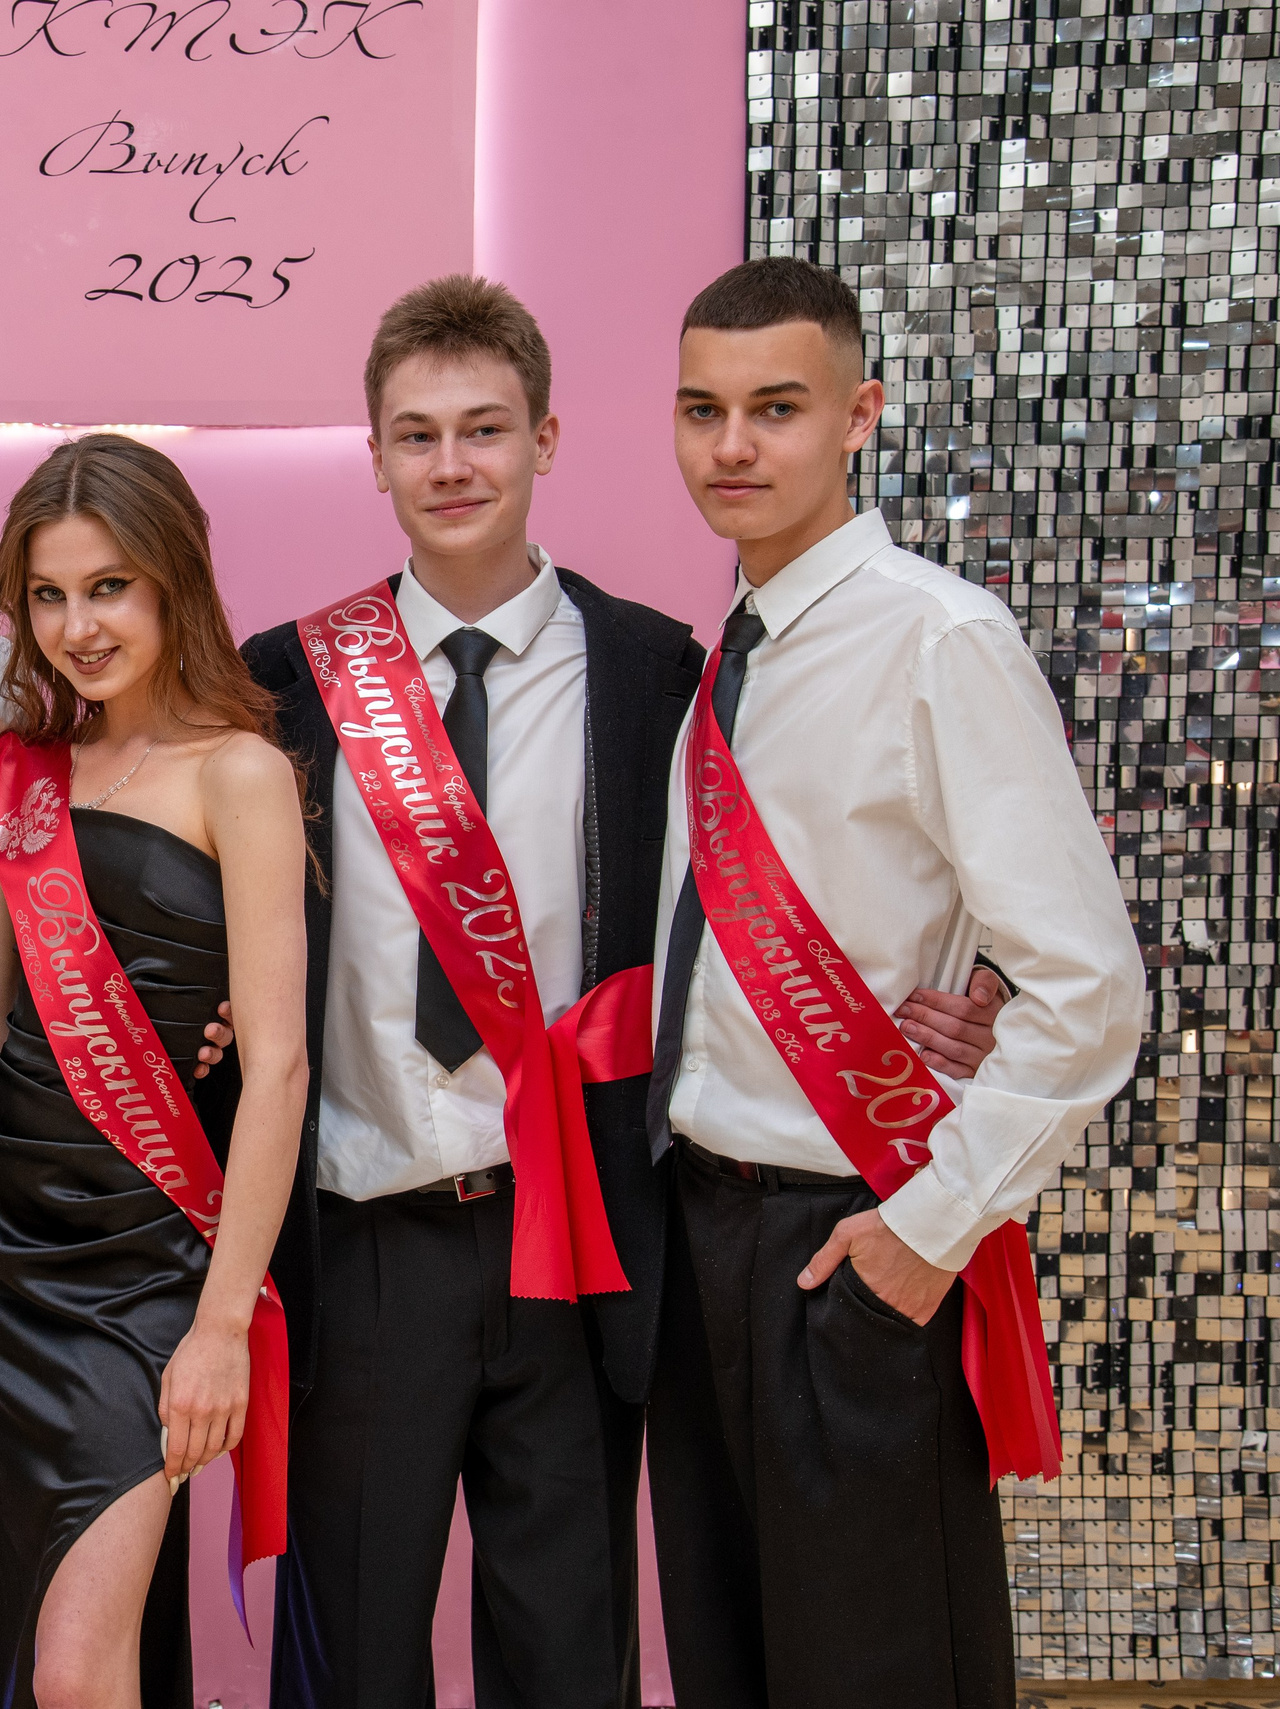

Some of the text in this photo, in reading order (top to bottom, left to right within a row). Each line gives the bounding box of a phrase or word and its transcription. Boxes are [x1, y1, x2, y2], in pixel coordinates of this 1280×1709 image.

[38, 110, 330, 224] Выпуск
[85, 247, 316, 308] 2025
[303, 623, 415, 872] КТЭК 22.193 Кк
[327, 596, 459, 865] Выпускник
[442, 775, 477, 832] Сергей
[694, 749, 943, 1168] Выпускник 202
[732, 956, 782, 1022] 22.193
[775, 1028, 804, 1064] Кк
[754, 850, 866, 1013] Тютрин Алексей
[16, 909, 54, 1002] КТЭК
[63, 1056, 108, 1122] 22.193
[26, 867, 190, 1196] Выпускница
[104, 972, 181, 1118] Сергеева Ксения
